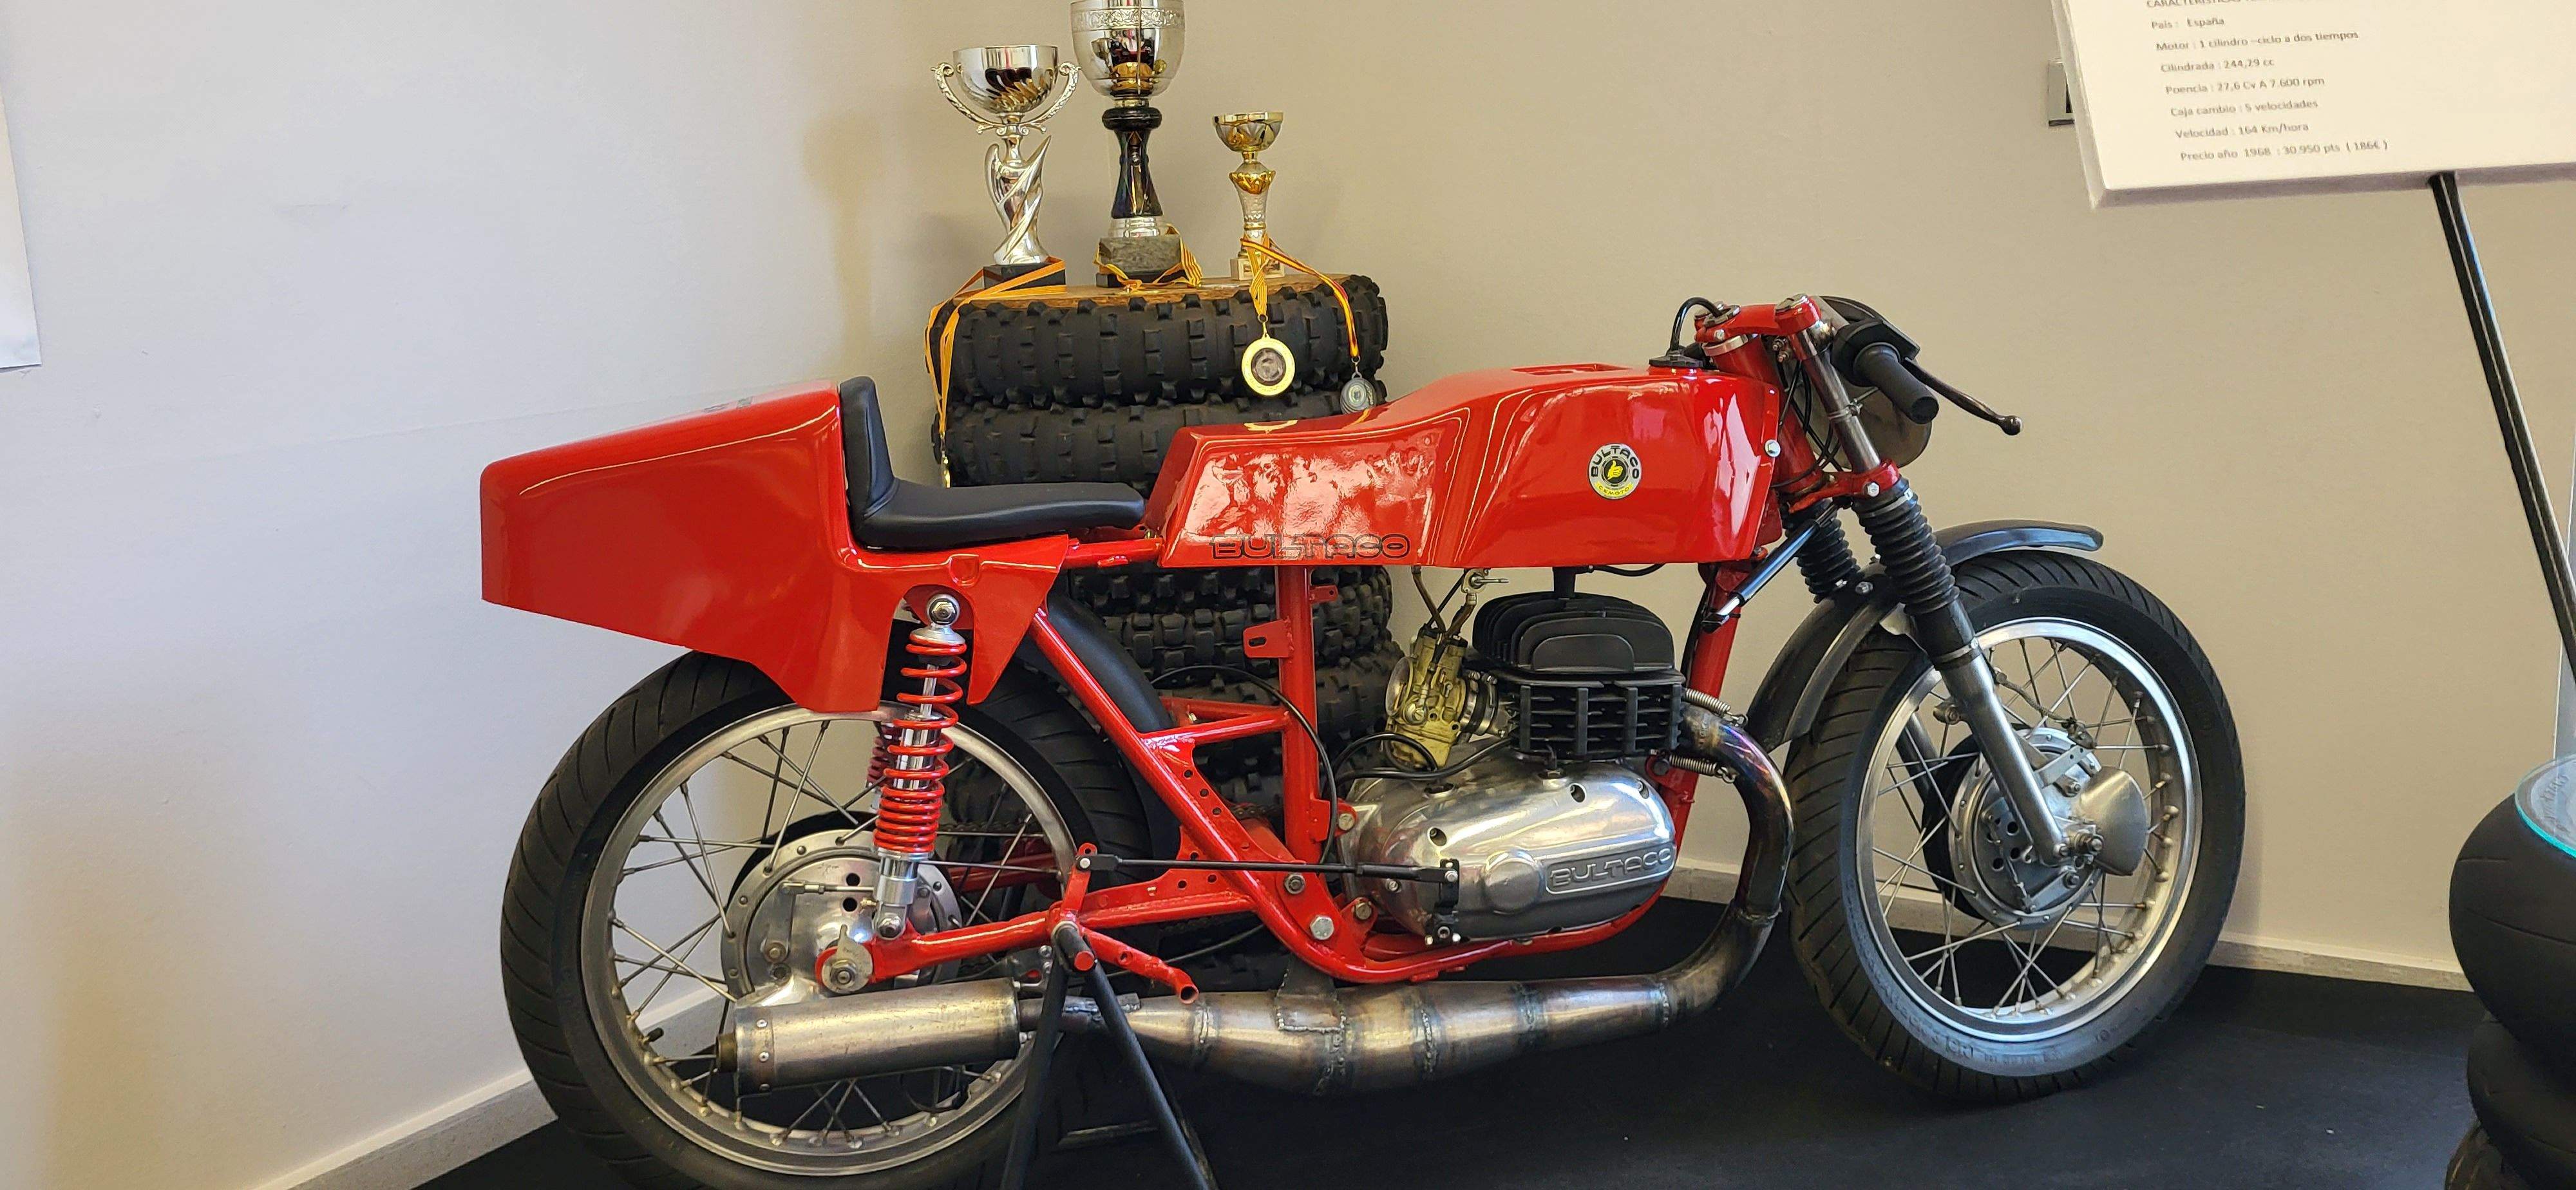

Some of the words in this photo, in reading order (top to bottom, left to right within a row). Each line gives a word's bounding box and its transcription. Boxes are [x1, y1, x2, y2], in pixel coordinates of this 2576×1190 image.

[2186, 17, 2225, 27] España
[2157, 41, 2189, 50] Motor
[2208, 37, 2248, 48] cilindro
[2294, 33, 2313, 42] dos
[2315, 32, 2359, 41] tiempos
[2161, 61, 2215, 73] Cilindrada
[2224, 59, 2260, 70] 244,29
[2166, 84, 2208, 95] Poencia
[2217, 81, 2240, 92] 27,6
[2243, 80, 2256, 90] Cv
[2259, 80, 2268, 89] A
[2302, 78, 2325, 88] rpm
[2170, 106, 2194, 117] Caja
[2196, 104, 2237, 115] cambio
[2255, 100, 2319, 111] velocidades
[2175, 126, 2229, 138] Velocidad
[2239, 125, 2258, 135] 164
[2261, 123, 2309, 134] Km/hora
[2181, 150, 2215, 161] Precio
[2217, 149, 2239, 159] año
[2244, 147, 2271, 158] 1968
[2323, 143, 2340, 155] pts
[1590, 445, 1640, 479] BULTACO
[1209, 533, 1411, 560] BULTACO
[1549, 847, 1672, 887] BULTACO
